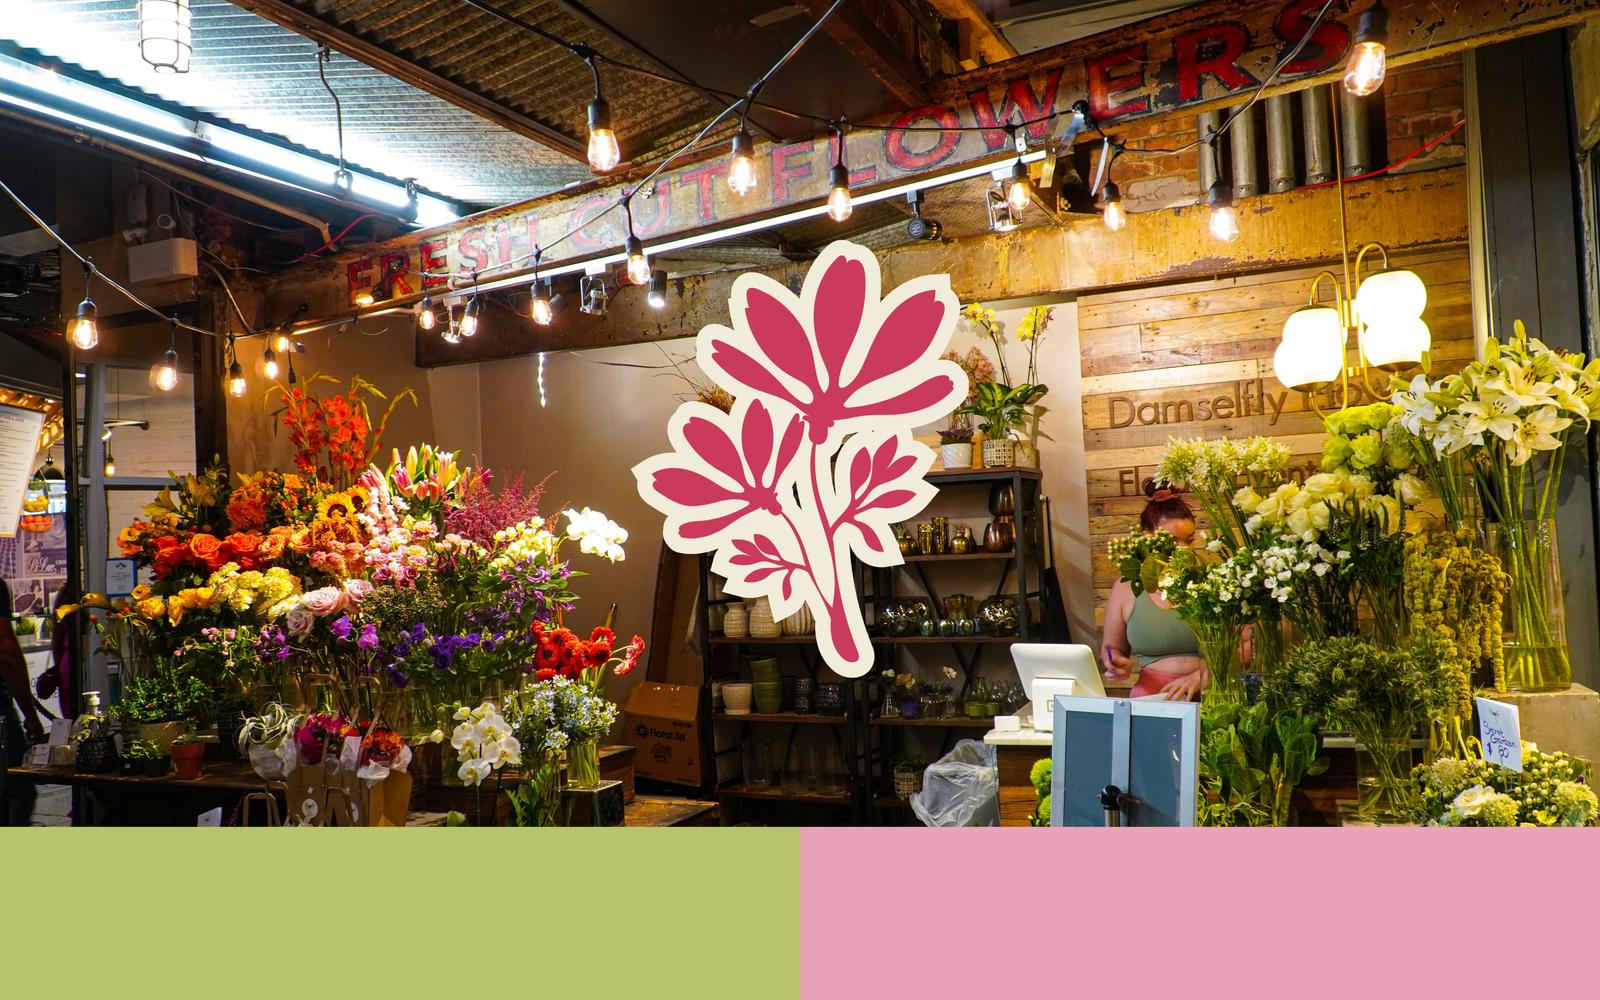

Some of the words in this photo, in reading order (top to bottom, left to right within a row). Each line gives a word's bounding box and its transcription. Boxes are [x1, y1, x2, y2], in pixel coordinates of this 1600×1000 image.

[347, 213, 542, 306] FRESH
[568, 164, 731, 250] CUT
[770, 0, 1352, 204] FLOWERS
[1108, 378, 1288, 429] Damselfly
